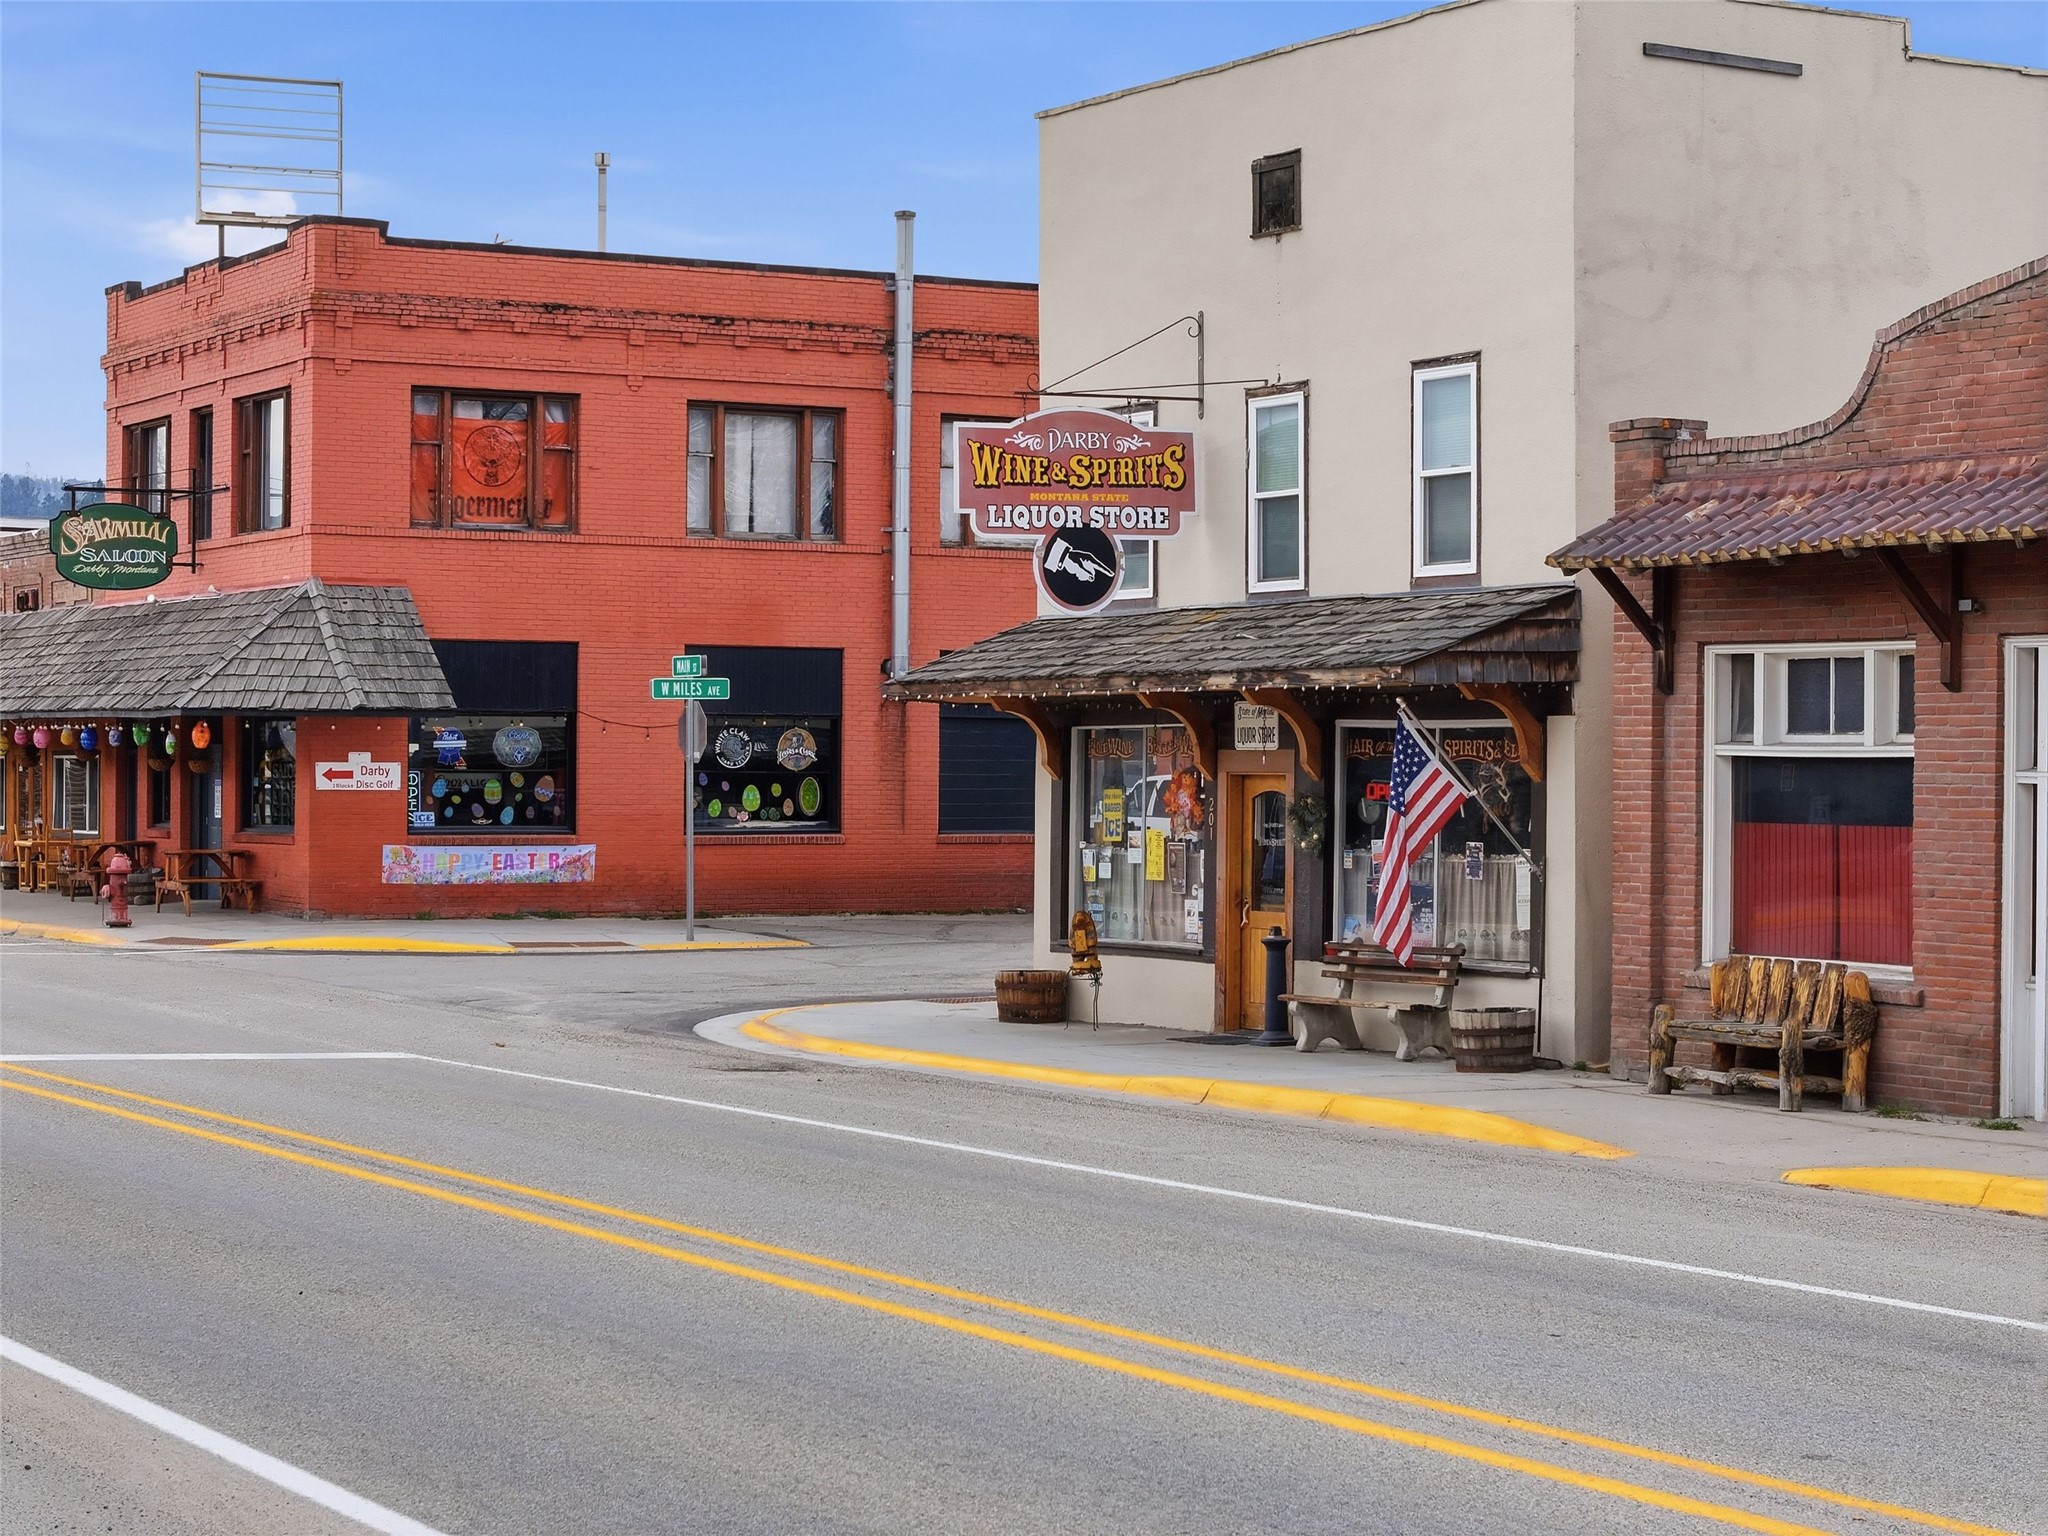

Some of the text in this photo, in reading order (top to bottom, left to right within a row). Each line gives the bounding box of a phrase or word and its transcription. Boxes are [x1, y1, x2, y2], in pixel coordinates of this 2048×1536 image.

[1048, 428, 1112, 452] DARBY
[967, 438, 1050, 489] WINE
[1068, 444, 1187, 490] SPIRITS
[1030, 493, 1129, 502] MONTANA STATE
[987, 505, 1170, 529] LIQUOR STORE
[61, 515, 170, 555] SAWMILL
[79, 547, 167, 564] SALOON
[112, 564, 159, 574] Montana
[676, 659, 691, 673] MAIN
[661, 682, 720, 696] W MILES AVE
[714, 727, 750, 754] WHITE CLAW
[1346, 738, 1375, 757] HAIR
[1443, 739, 1494, 760] SPIRITS
[360, 765, 391, 778] Darby
[356, 780, 394, 789] Disc Golf
[415, 814, 433, 822] ICE
[1105, 817, 1121, 838] ICE
[422, 852, 560, 871] HAPPY EASTER
